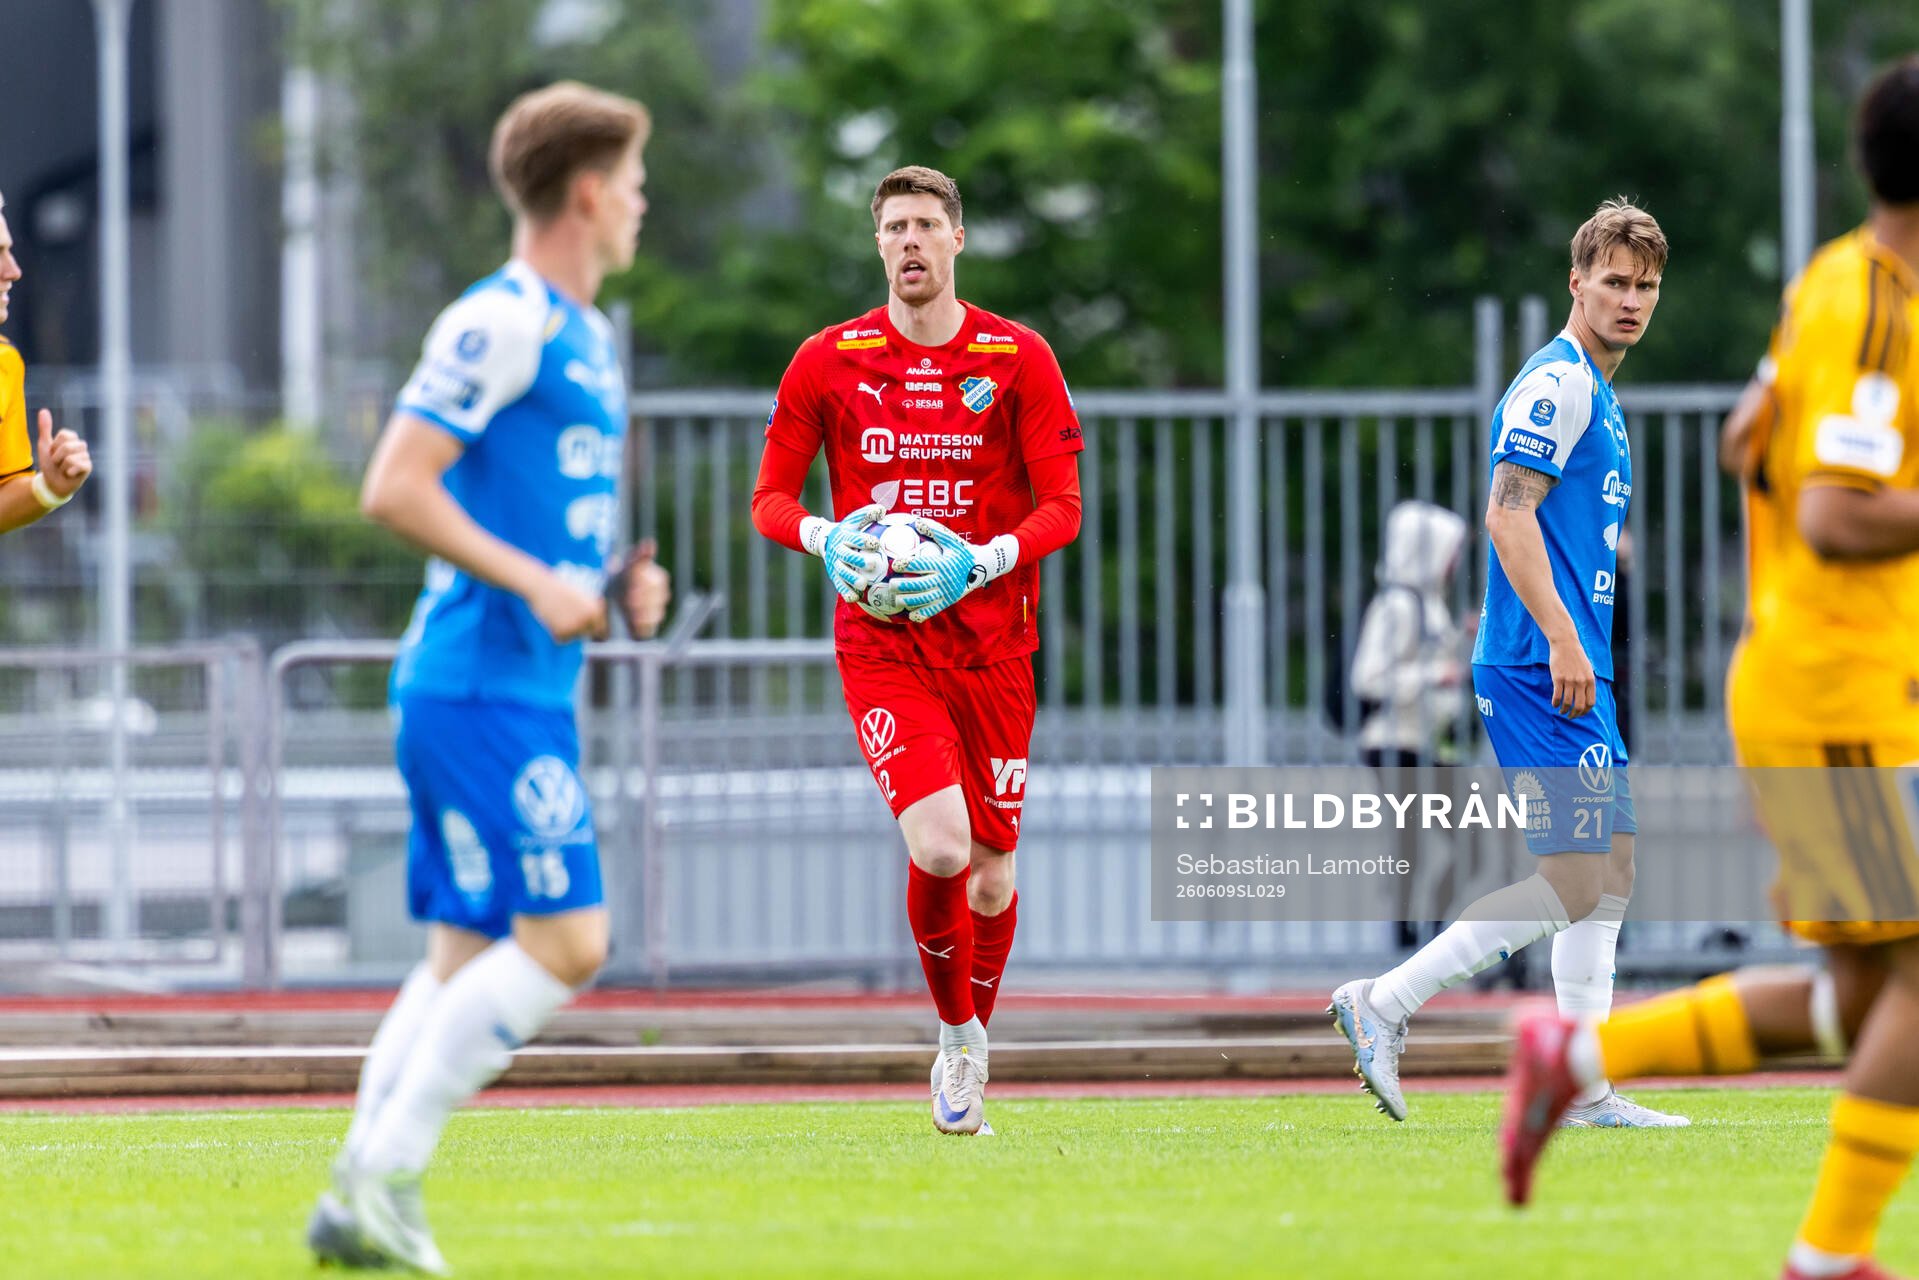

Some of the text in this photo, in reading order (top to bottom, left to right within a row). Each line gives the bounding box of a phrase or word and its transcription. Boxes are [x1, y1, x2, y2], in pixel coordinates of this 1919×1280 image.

[906, 367, 943, 375] ANACKA
[915, 399, 943, 408] SESAB
[899, 433, 983, 446] MATTSSON
[1509, 431, 1554, 456] UNIBET
[898, 447, 972, 460] GRUPPEN
[903, 479, 974, 506] EBC
[911, 508, 967, 518] GROUP
[1573, 808, 1602, 839] 21
